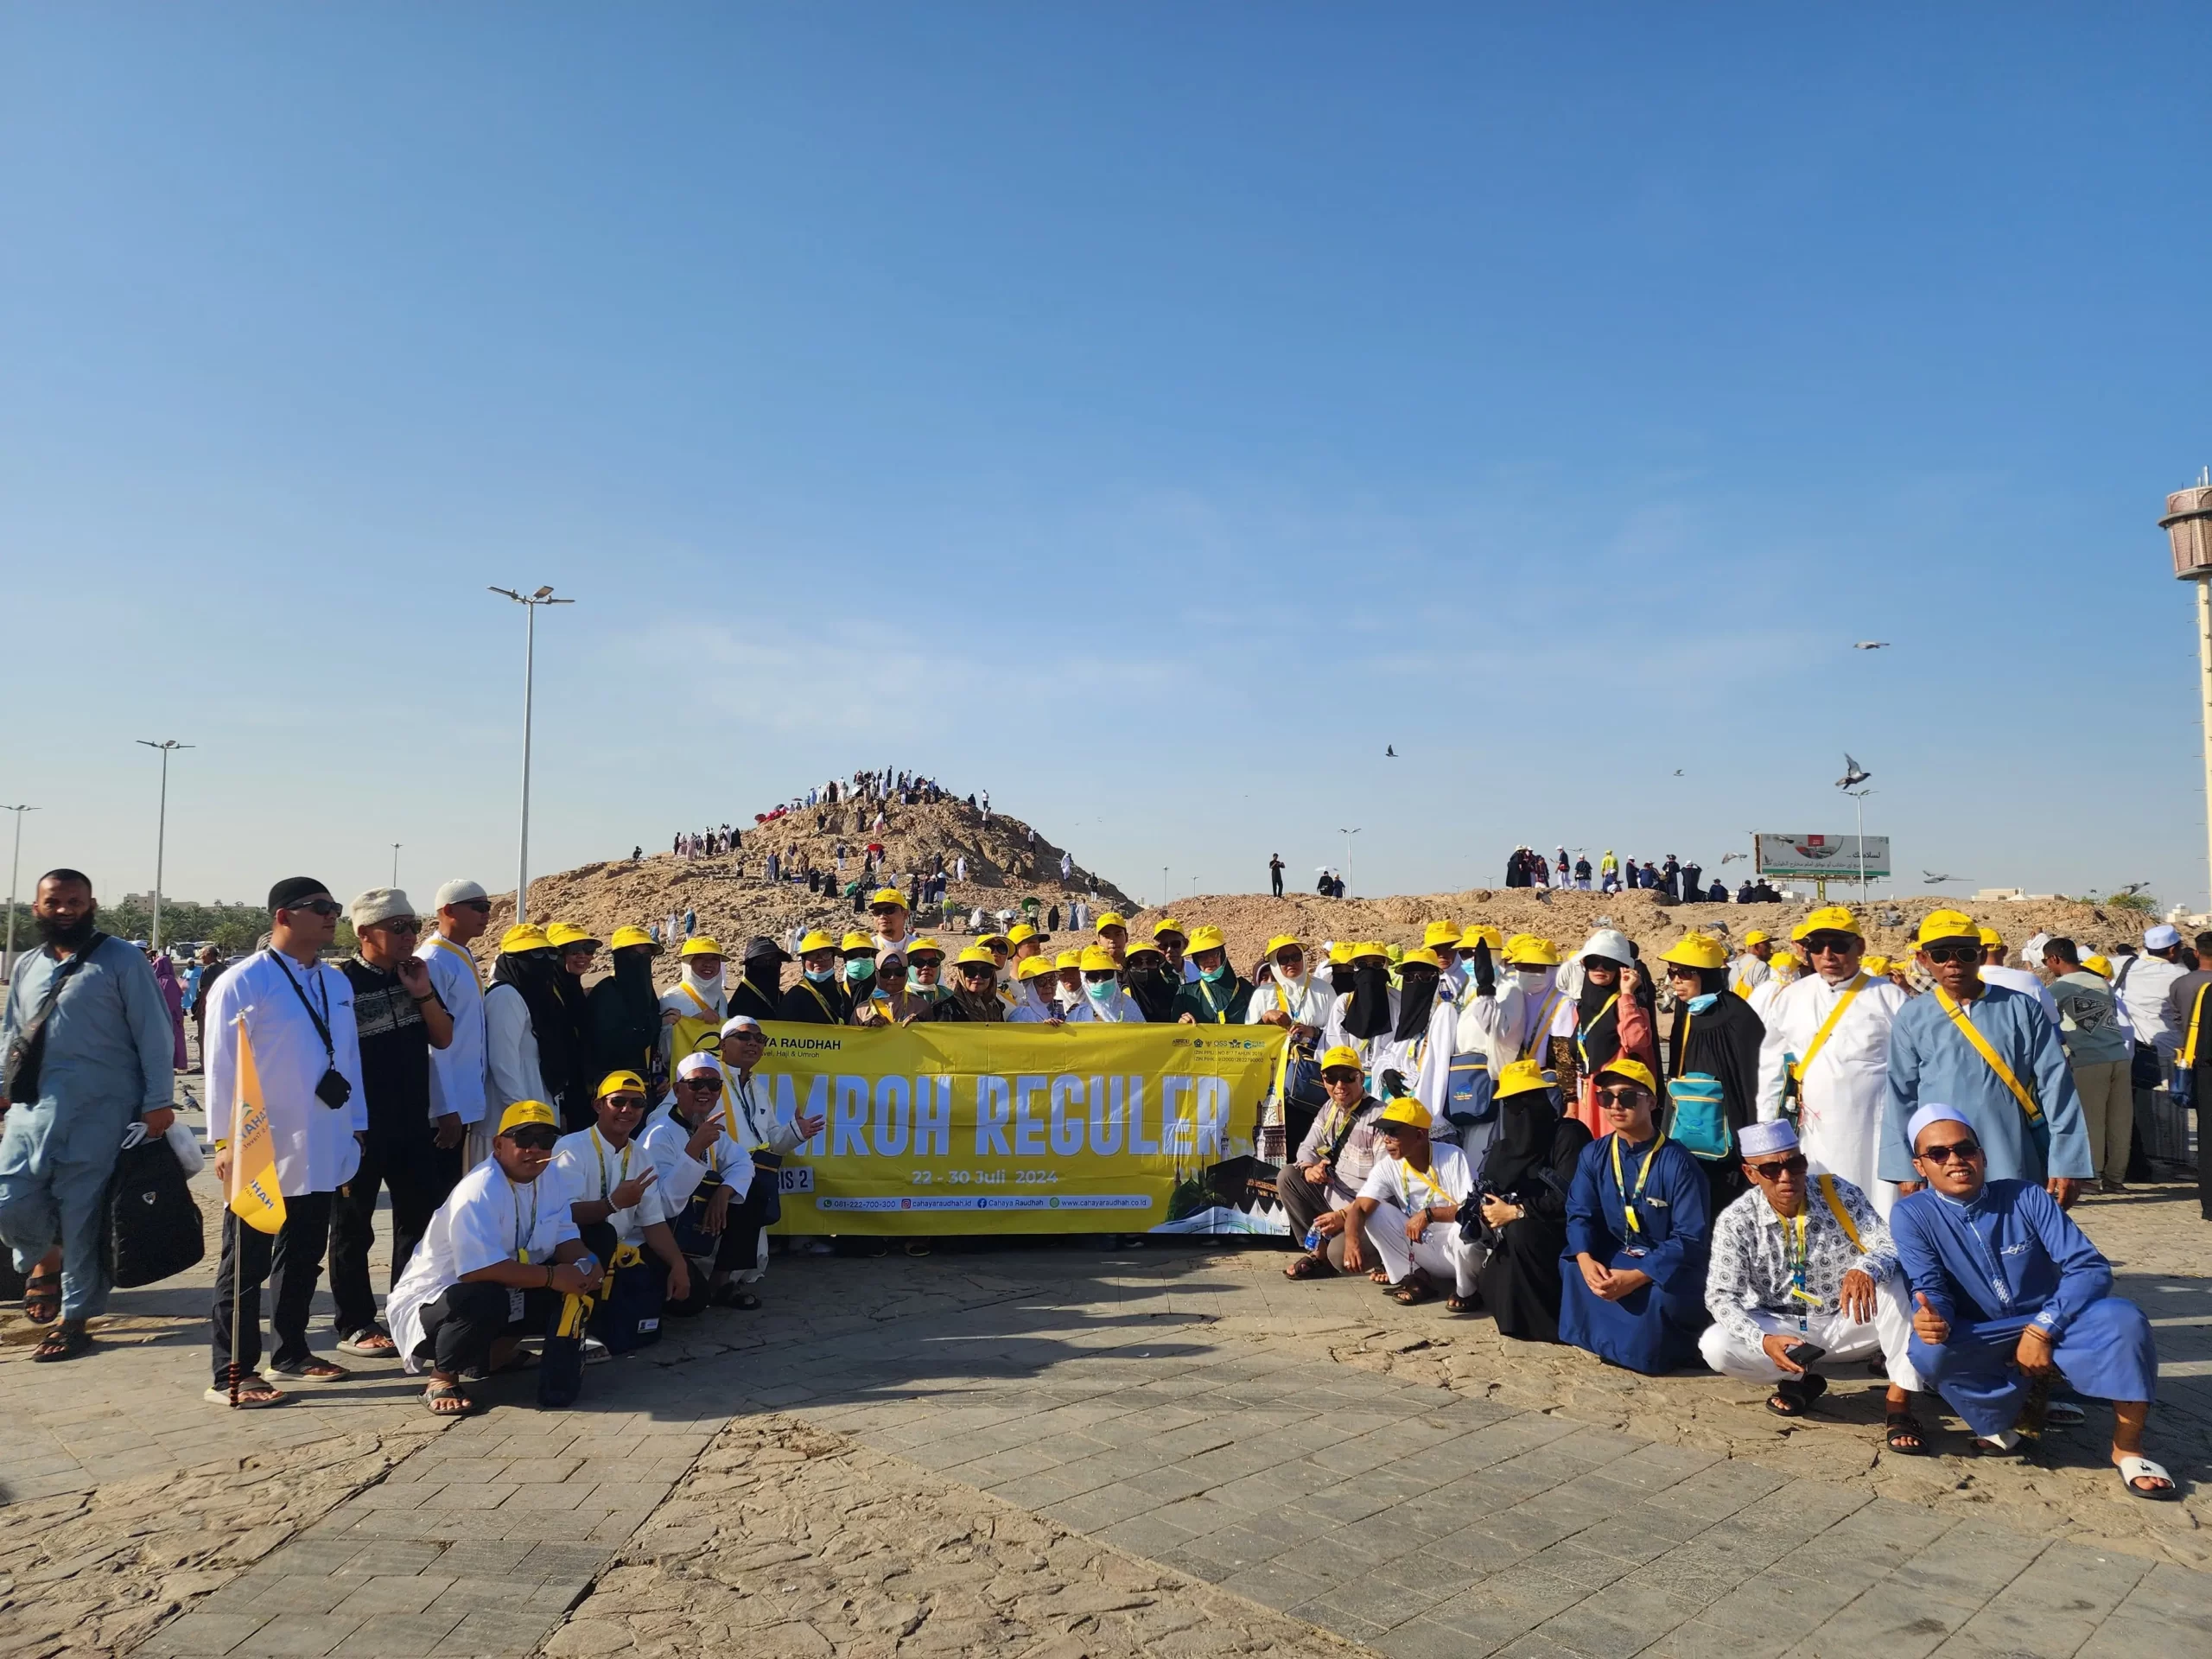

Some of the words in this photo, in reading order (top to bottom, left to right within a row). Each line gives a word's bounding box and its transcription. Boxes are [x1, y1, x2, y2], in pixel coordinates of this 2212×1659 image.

[780, 1038, 841, 1050] RAUDHAH
[755, 1073, 951, 1158] MROH
[975, 1074, 1231, 1157] REGULER
[779, 1170, 794, 1190] IS
[799, 1169, 809, 1189] 2
[912, 1171, 932, 1185] 22
[948, 1170, 970, 1185] 30
[975, 1169, 1006, 1185] Juli
[1015, 1170, 1058, 1184] 2024
[834, 1199, 896, 1209] 081-222-700-300
[912, 1198, 972, 1209] cahayaraudhah.id
[988, 1199, 1014, 1208] Cahaya
[1014, 1198, 1044, 1207] Raudhah
[1061, 1198, 1147, 1207] www.cahayaraudhah.co.id
